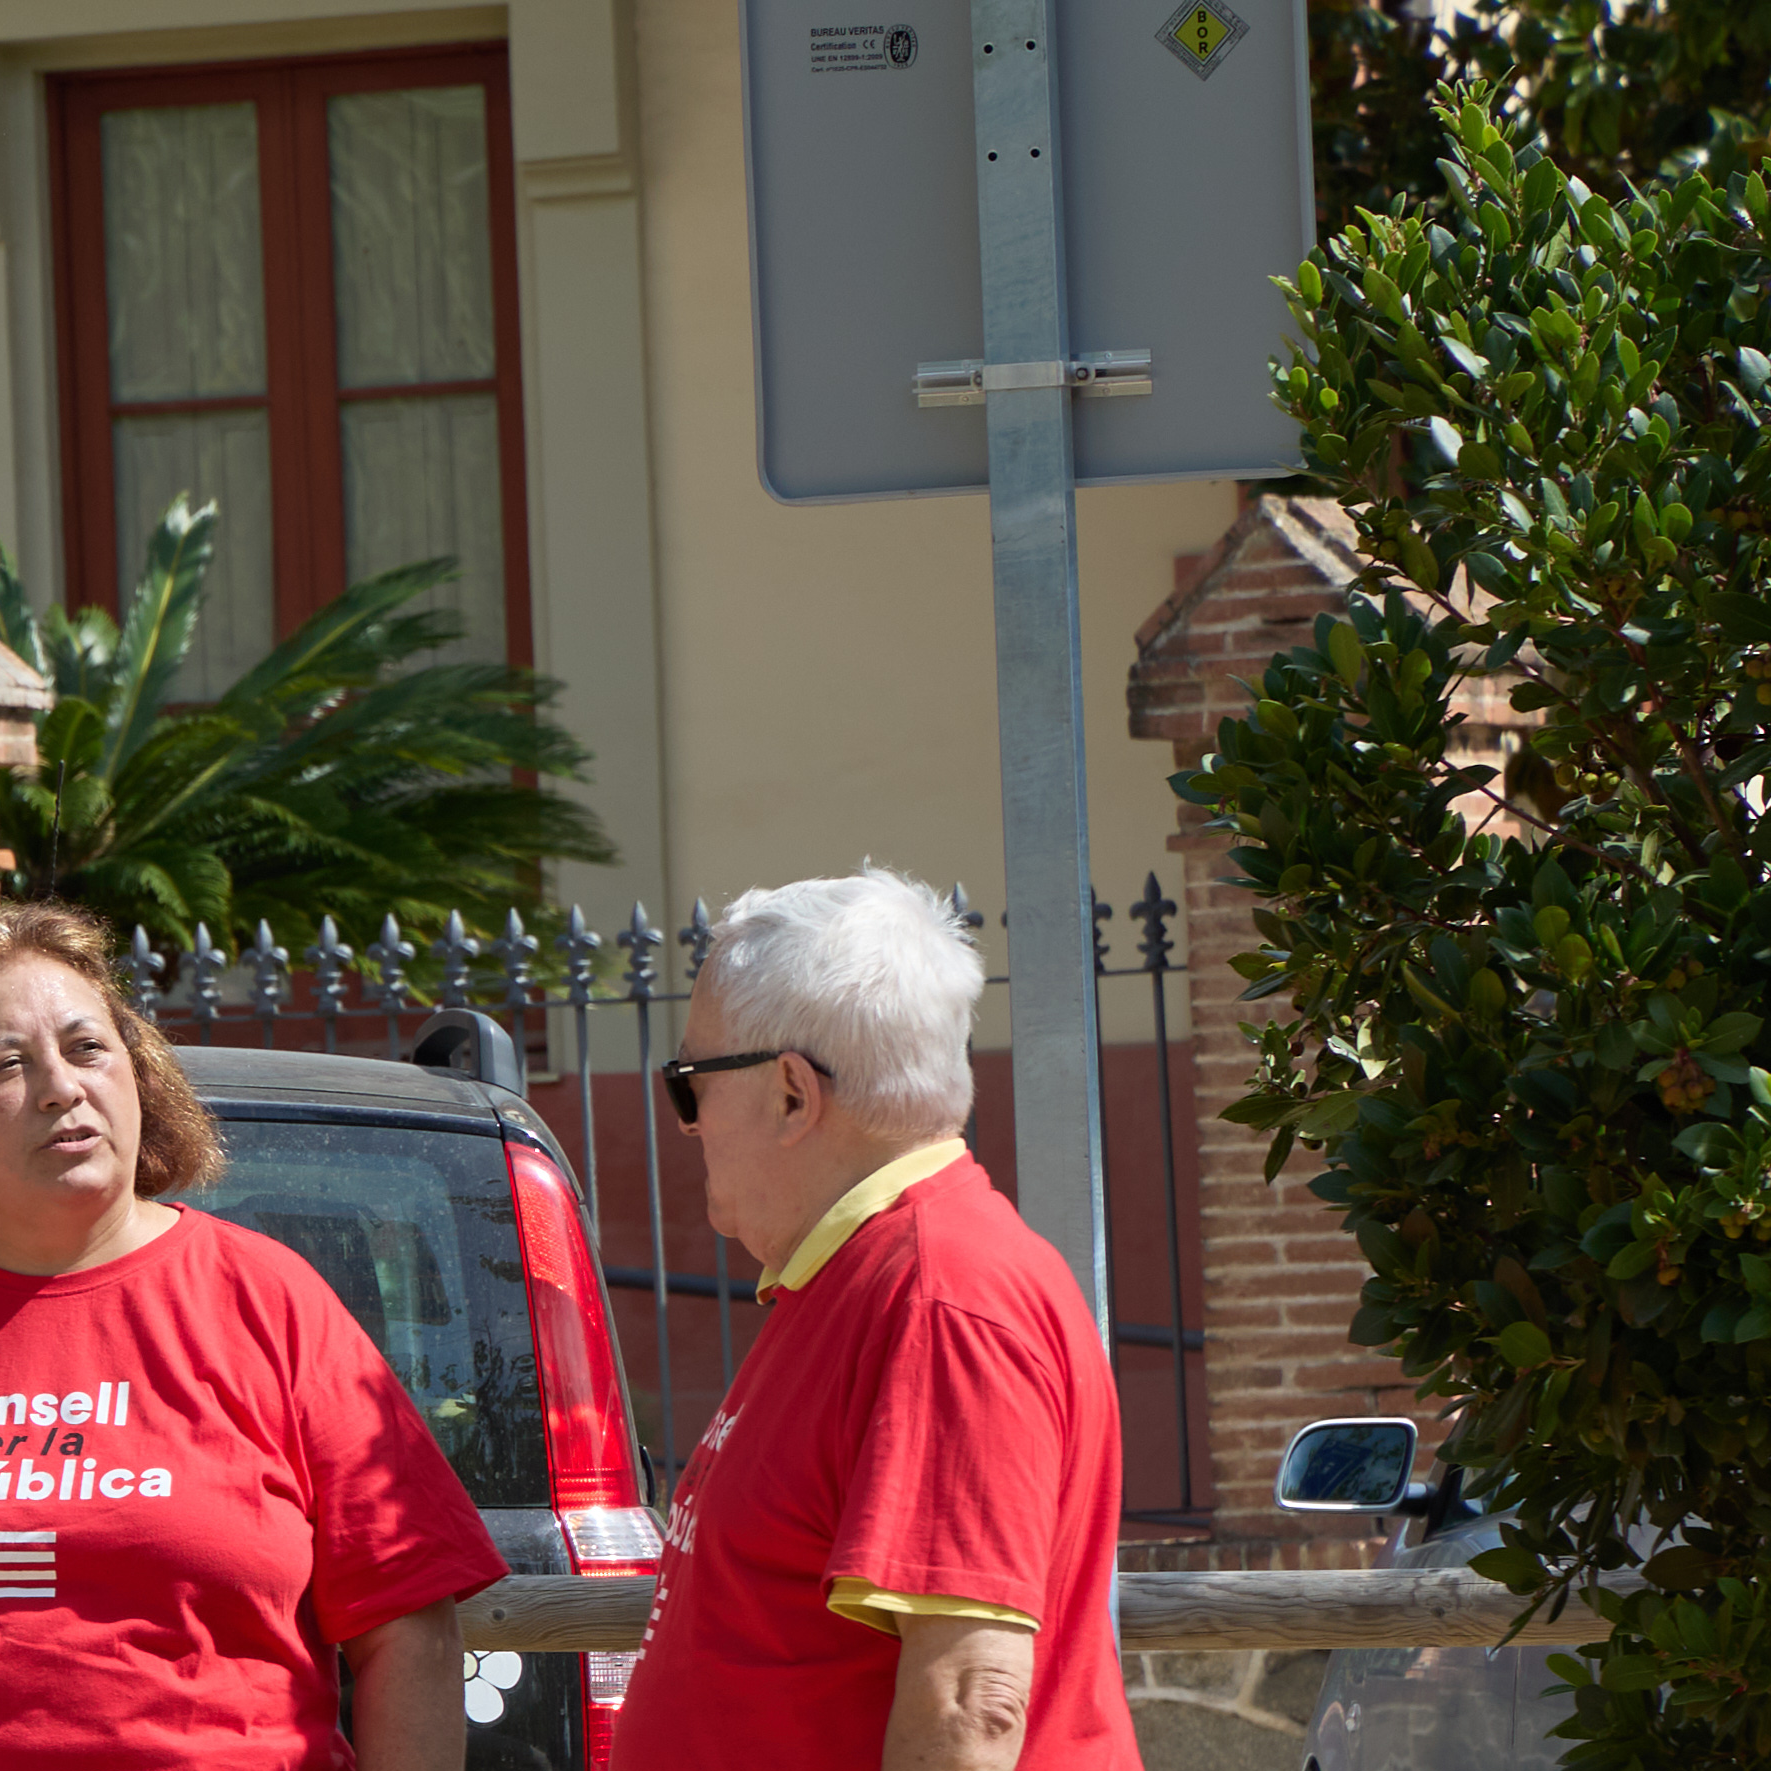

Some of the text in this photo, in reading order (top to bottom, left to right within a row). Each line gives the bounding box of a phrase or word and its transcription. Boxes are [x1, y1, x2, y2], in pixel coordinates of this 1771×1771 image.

[811, 25, 884, 37] BUREAU VERITAS
[40, 1428, 85, 1456] la
